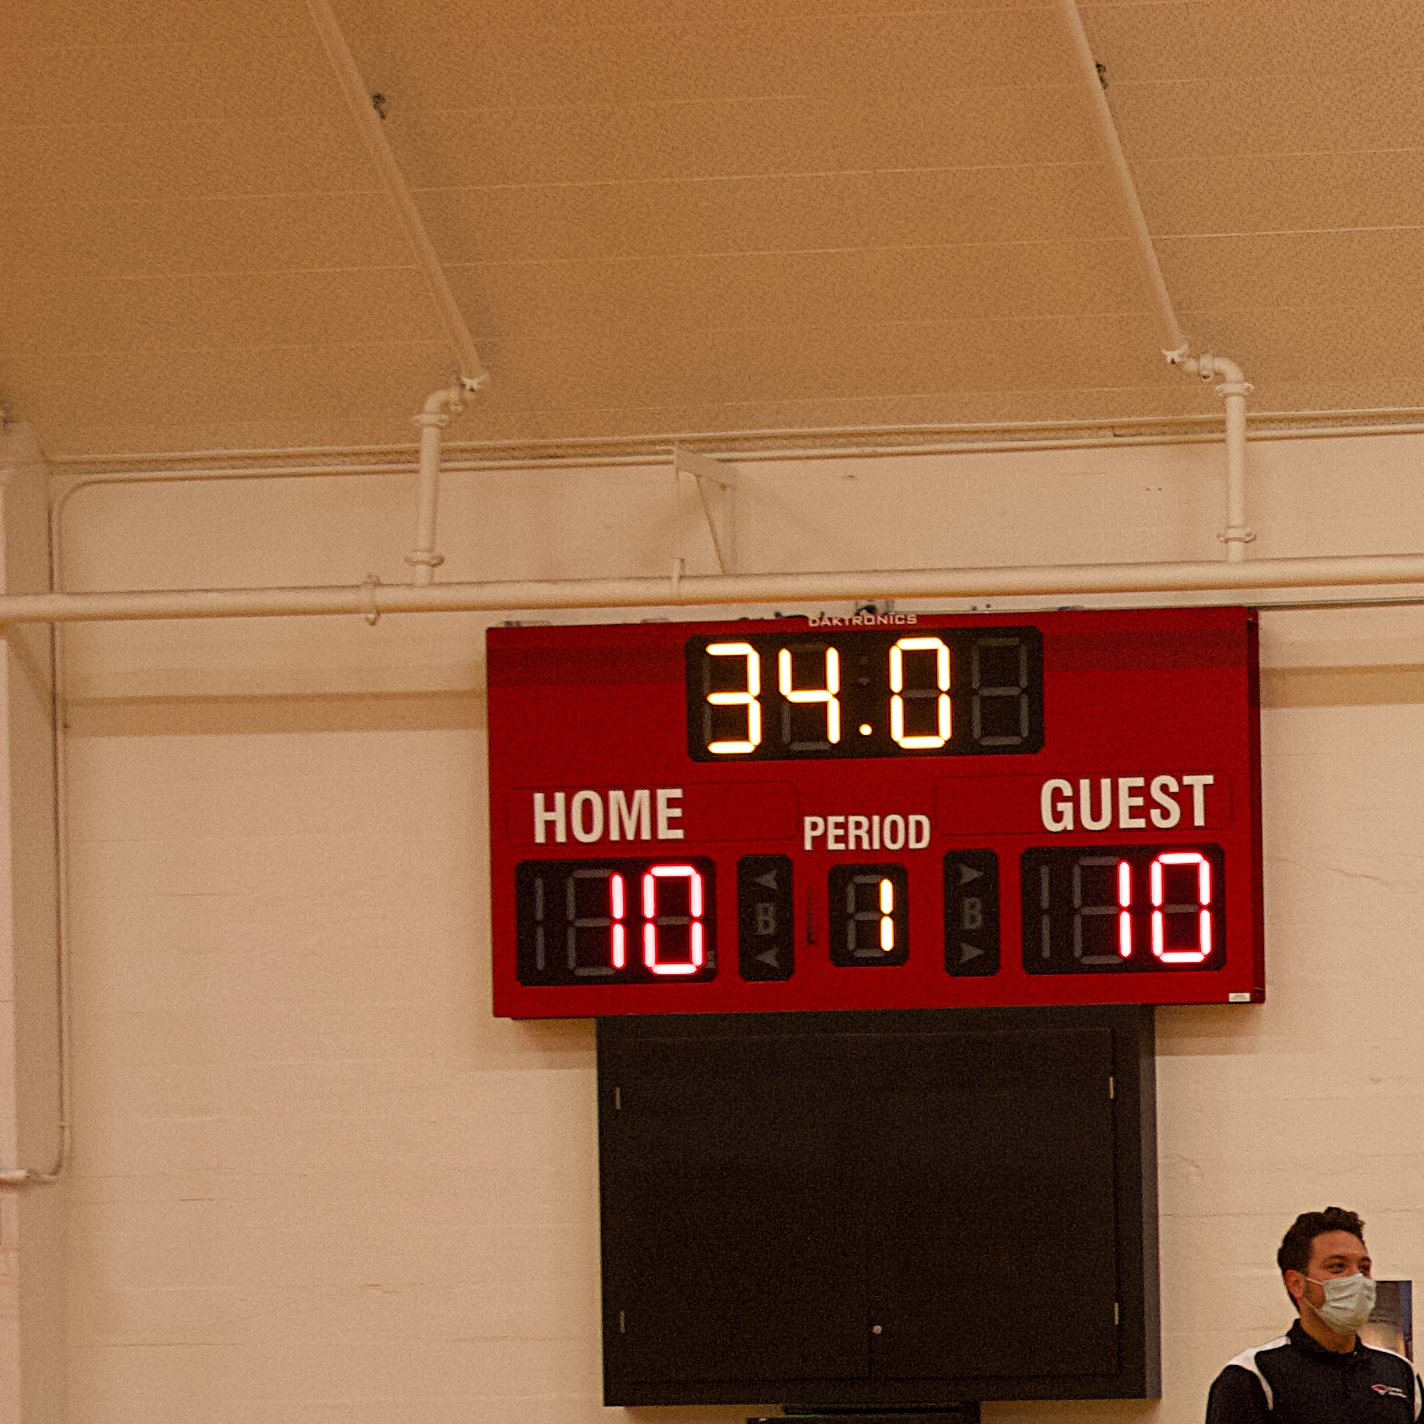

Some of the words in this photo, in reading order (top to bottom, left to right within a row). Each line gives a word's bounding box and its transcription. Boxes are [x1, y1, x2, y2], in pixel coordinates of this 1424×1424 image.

[807, 614, 917, 627] DAKTRONICS
[706, 637, 951, 754] 34.0
[533, 788, 685, 844] HOME
[803, 814, 931, 851] PERIOD
[1040, 774, 1215, 833] GUEST
[610, 865, 704, 976] 10
[877, 877, 895, 953] 1
[1117, 852, 1213, 964] 10
